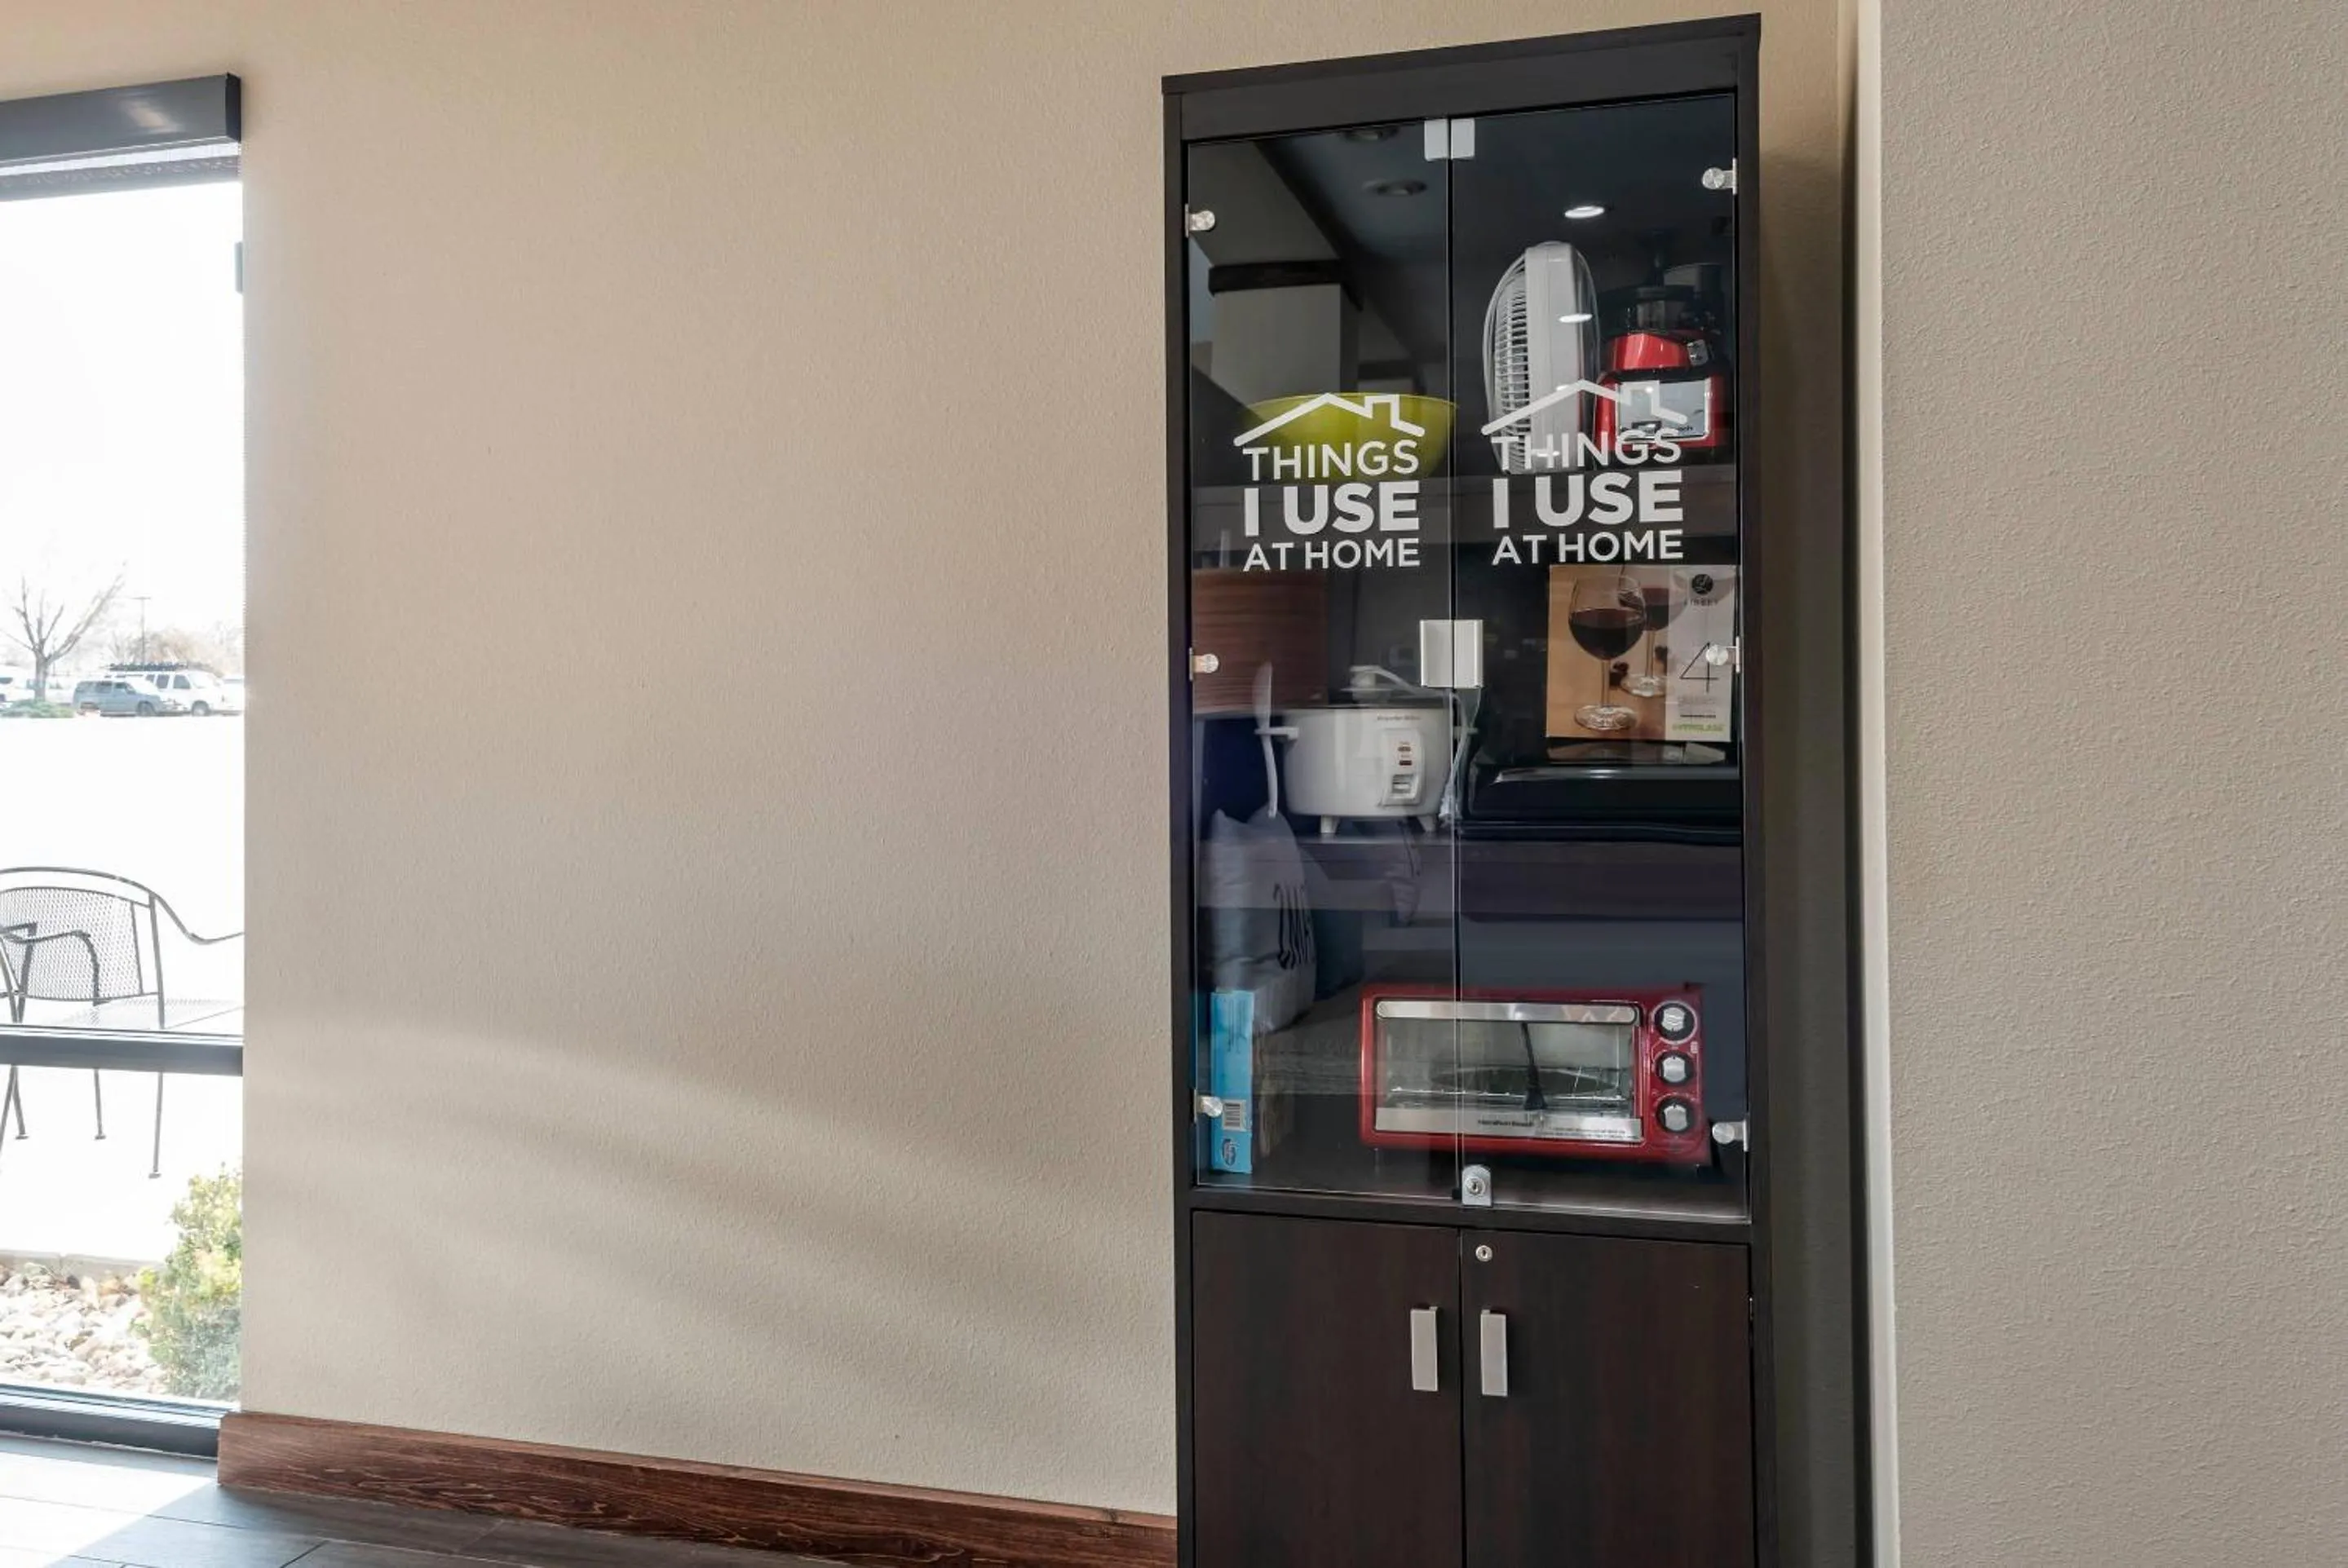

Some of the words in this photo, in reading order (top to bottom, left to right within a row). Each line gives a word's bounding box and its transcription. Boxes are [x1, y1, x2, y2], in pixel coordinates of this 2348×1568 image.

[1242, 439, 1420, 481] THINGS
[1491, 428, 1683, 470] THINGS
[1245, 488, 1259, 537] I
[1283, 479, 1420, 535] USE
[1493, 479, 1510, 528] I
[1535, 470, 1683, 527] USE
[1243, 541, 1294, 572] AT
[1305, 537, 1421, 570] HOME
[1492, 534, 1547, 565] AT
[1559, 529, 1683, 563] HOME
[1678, 642, 1718, 693] 4
